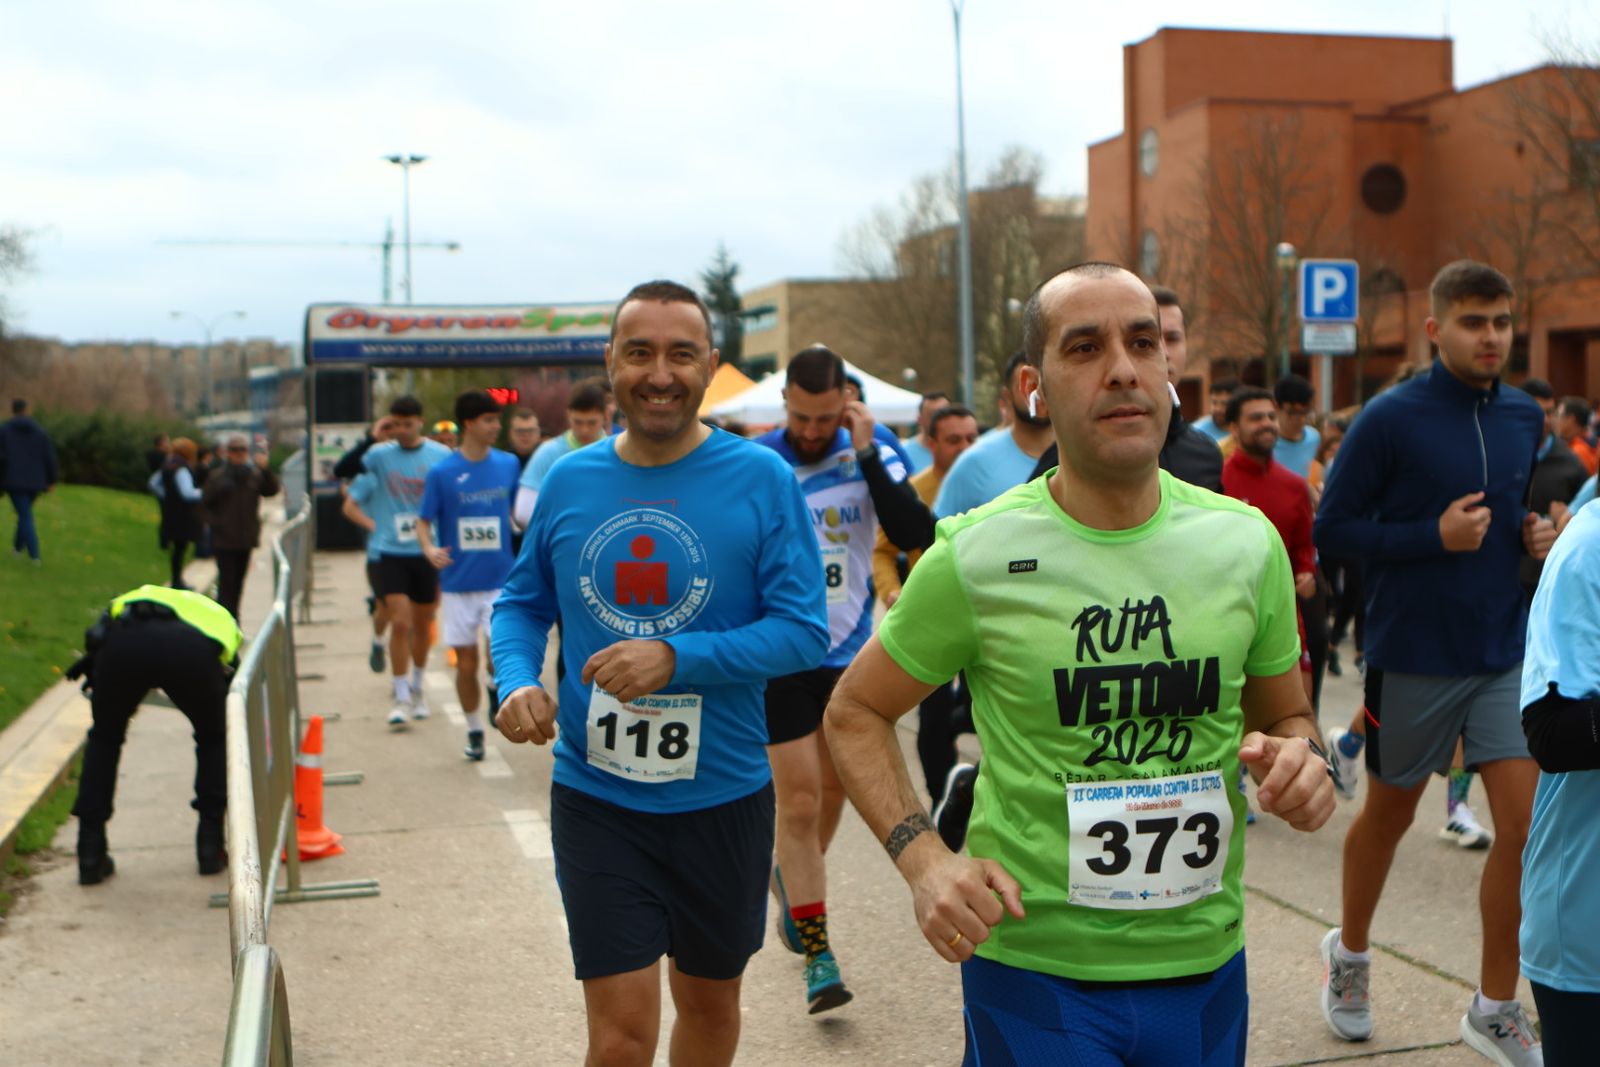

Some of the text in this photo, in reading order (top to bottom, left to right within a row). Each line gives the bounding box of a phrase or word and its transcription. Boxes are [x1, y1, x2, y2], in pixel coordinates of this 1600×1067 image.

[1313, 267, 1347, 314] P
[361, 339, 606, 356] www.orycronsport.co
[463, 526, 496, 541] 336
[642, 514, 681, 533] SEPTEMBER
[689, 545, 701, 563] 2015
[579, 576, 708, 635] ANYTHING IS POSSIBLE
[1071, 595, 1178, 663] RUTA
[1053, 656, 1221, 727] VETONA
[597, 711, 689, 760] 118
[1083, 717, 1195, 766] 2025
[1074, 776, 1221, 802] II CARRERA POPULAR CONTRA EL ICTUS
[1086, 812, 1220, 876] 373
